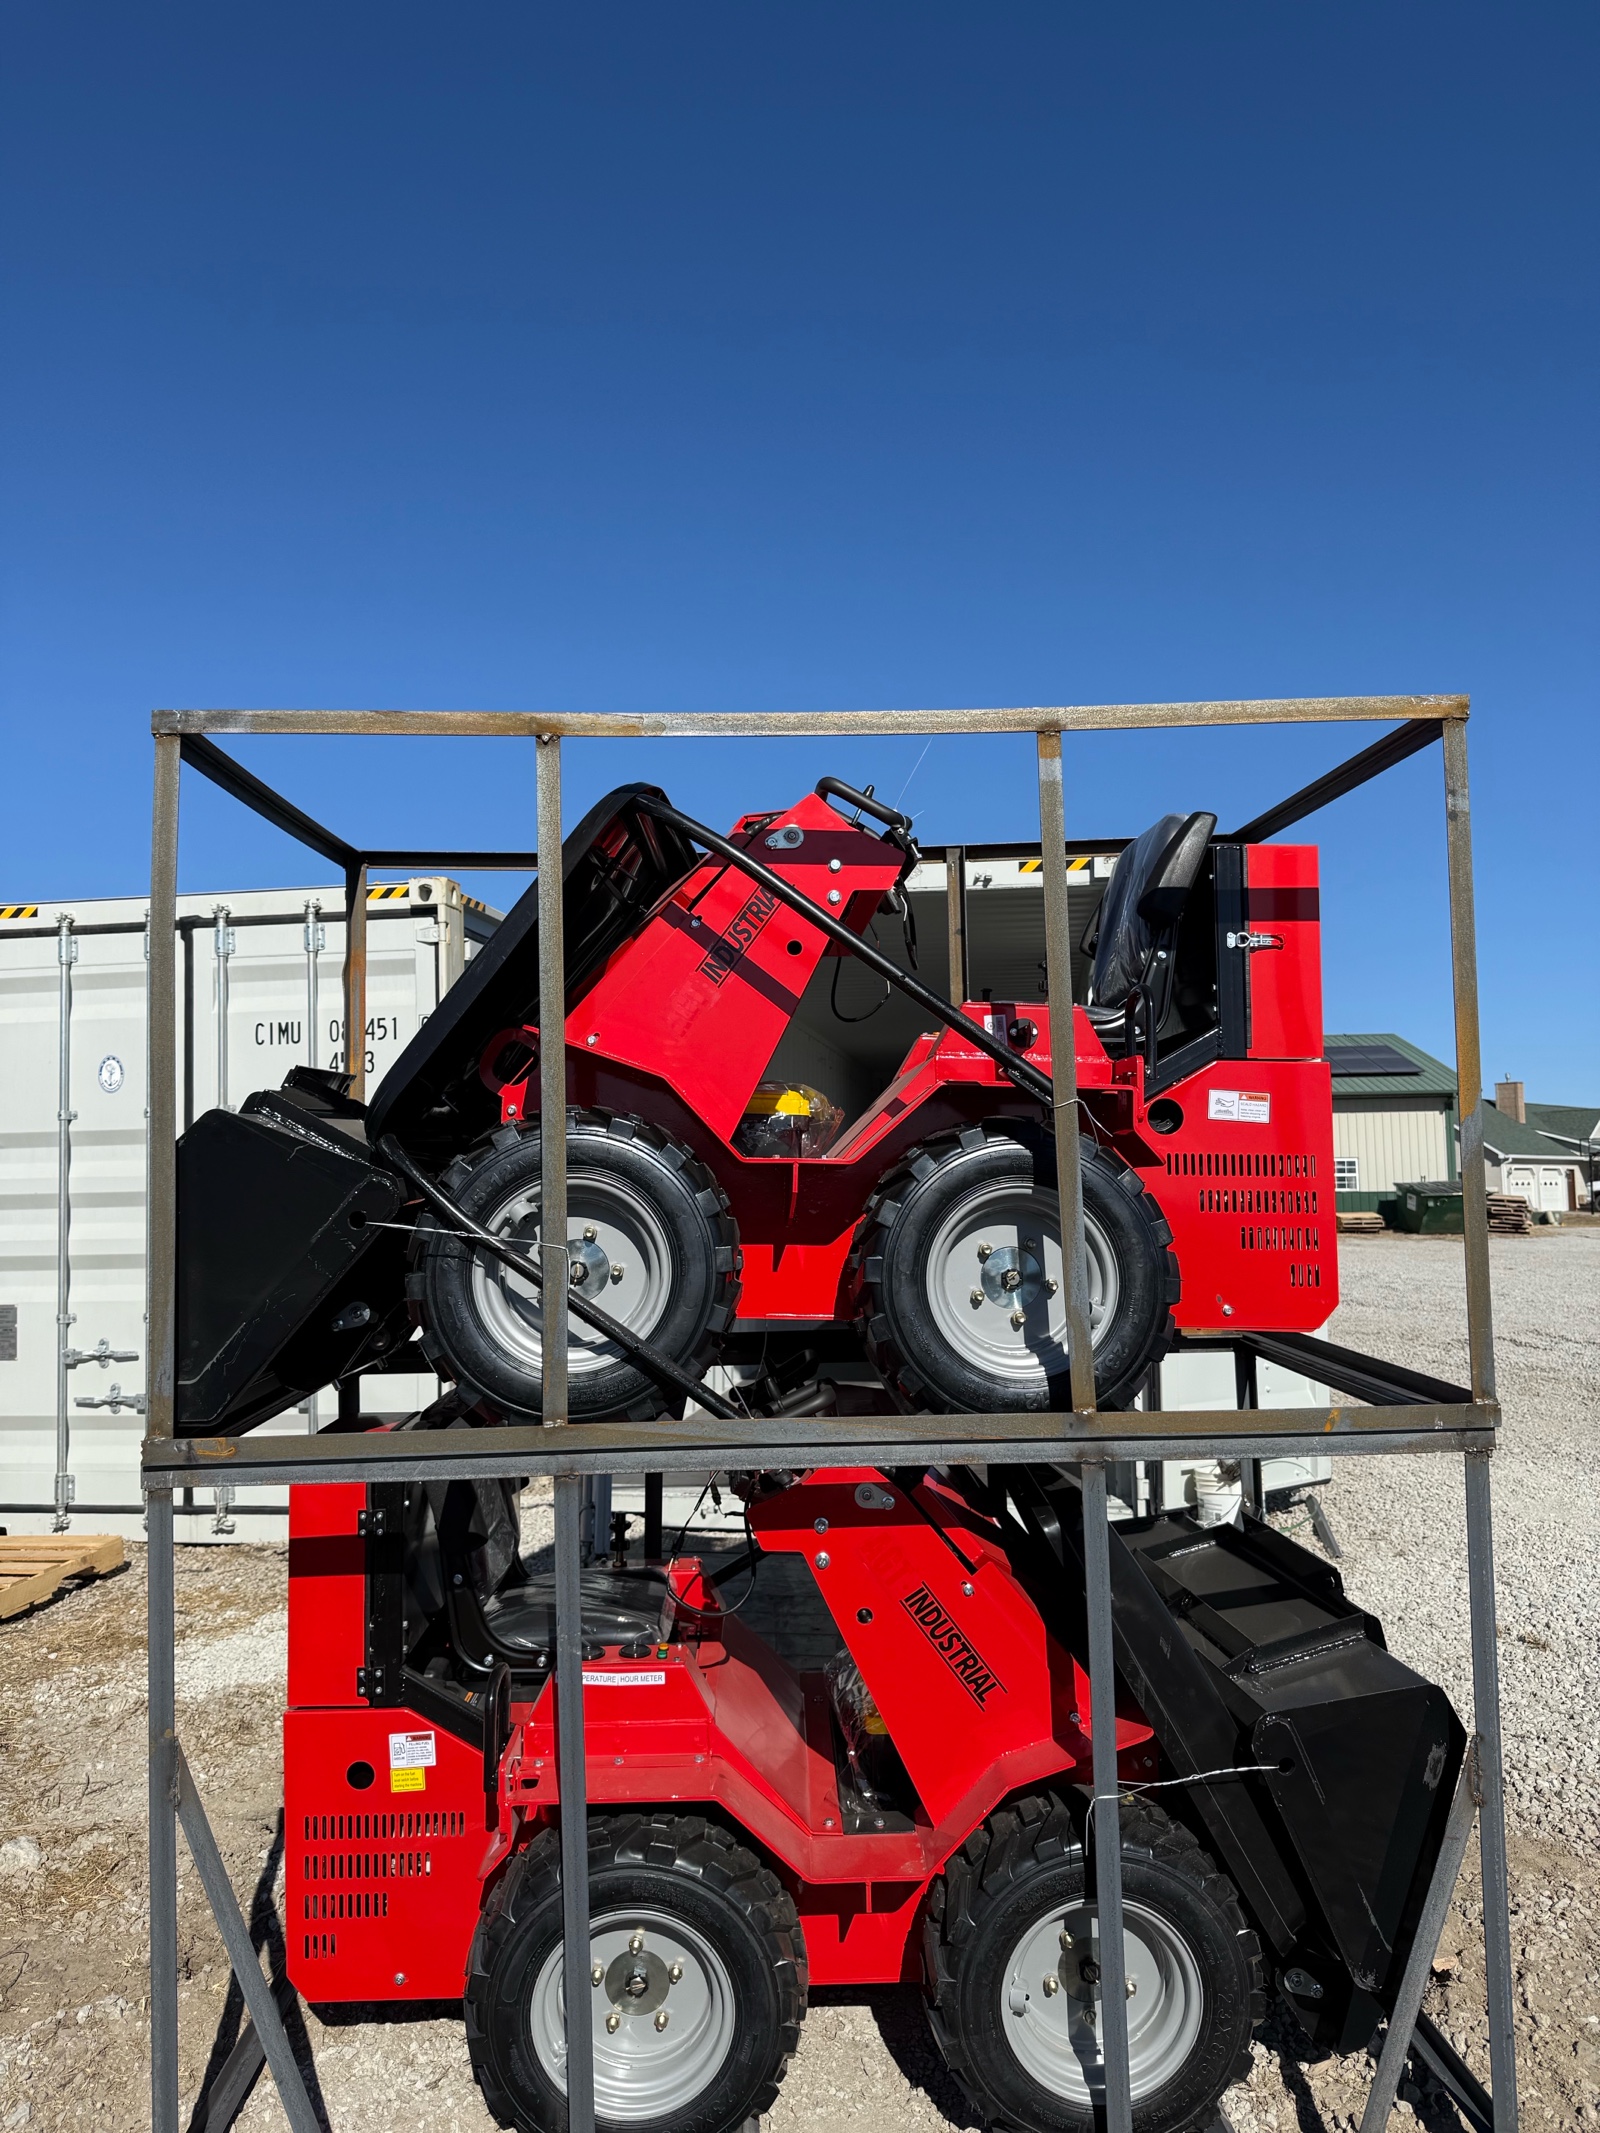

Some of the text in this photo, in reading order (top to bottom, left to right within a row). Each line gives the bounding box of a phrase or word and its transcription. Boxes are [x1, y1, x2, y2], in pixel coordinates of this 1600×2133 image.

[700, 887, 776, 985] INDUSTRIA
[255, 1021, 301, 1045] CIMU
[329, 1017, 398, 1042] 0451
[903, 1586, 998, 1704] INDUSTRIAL
[640, 1674, 663, 1682] METER
